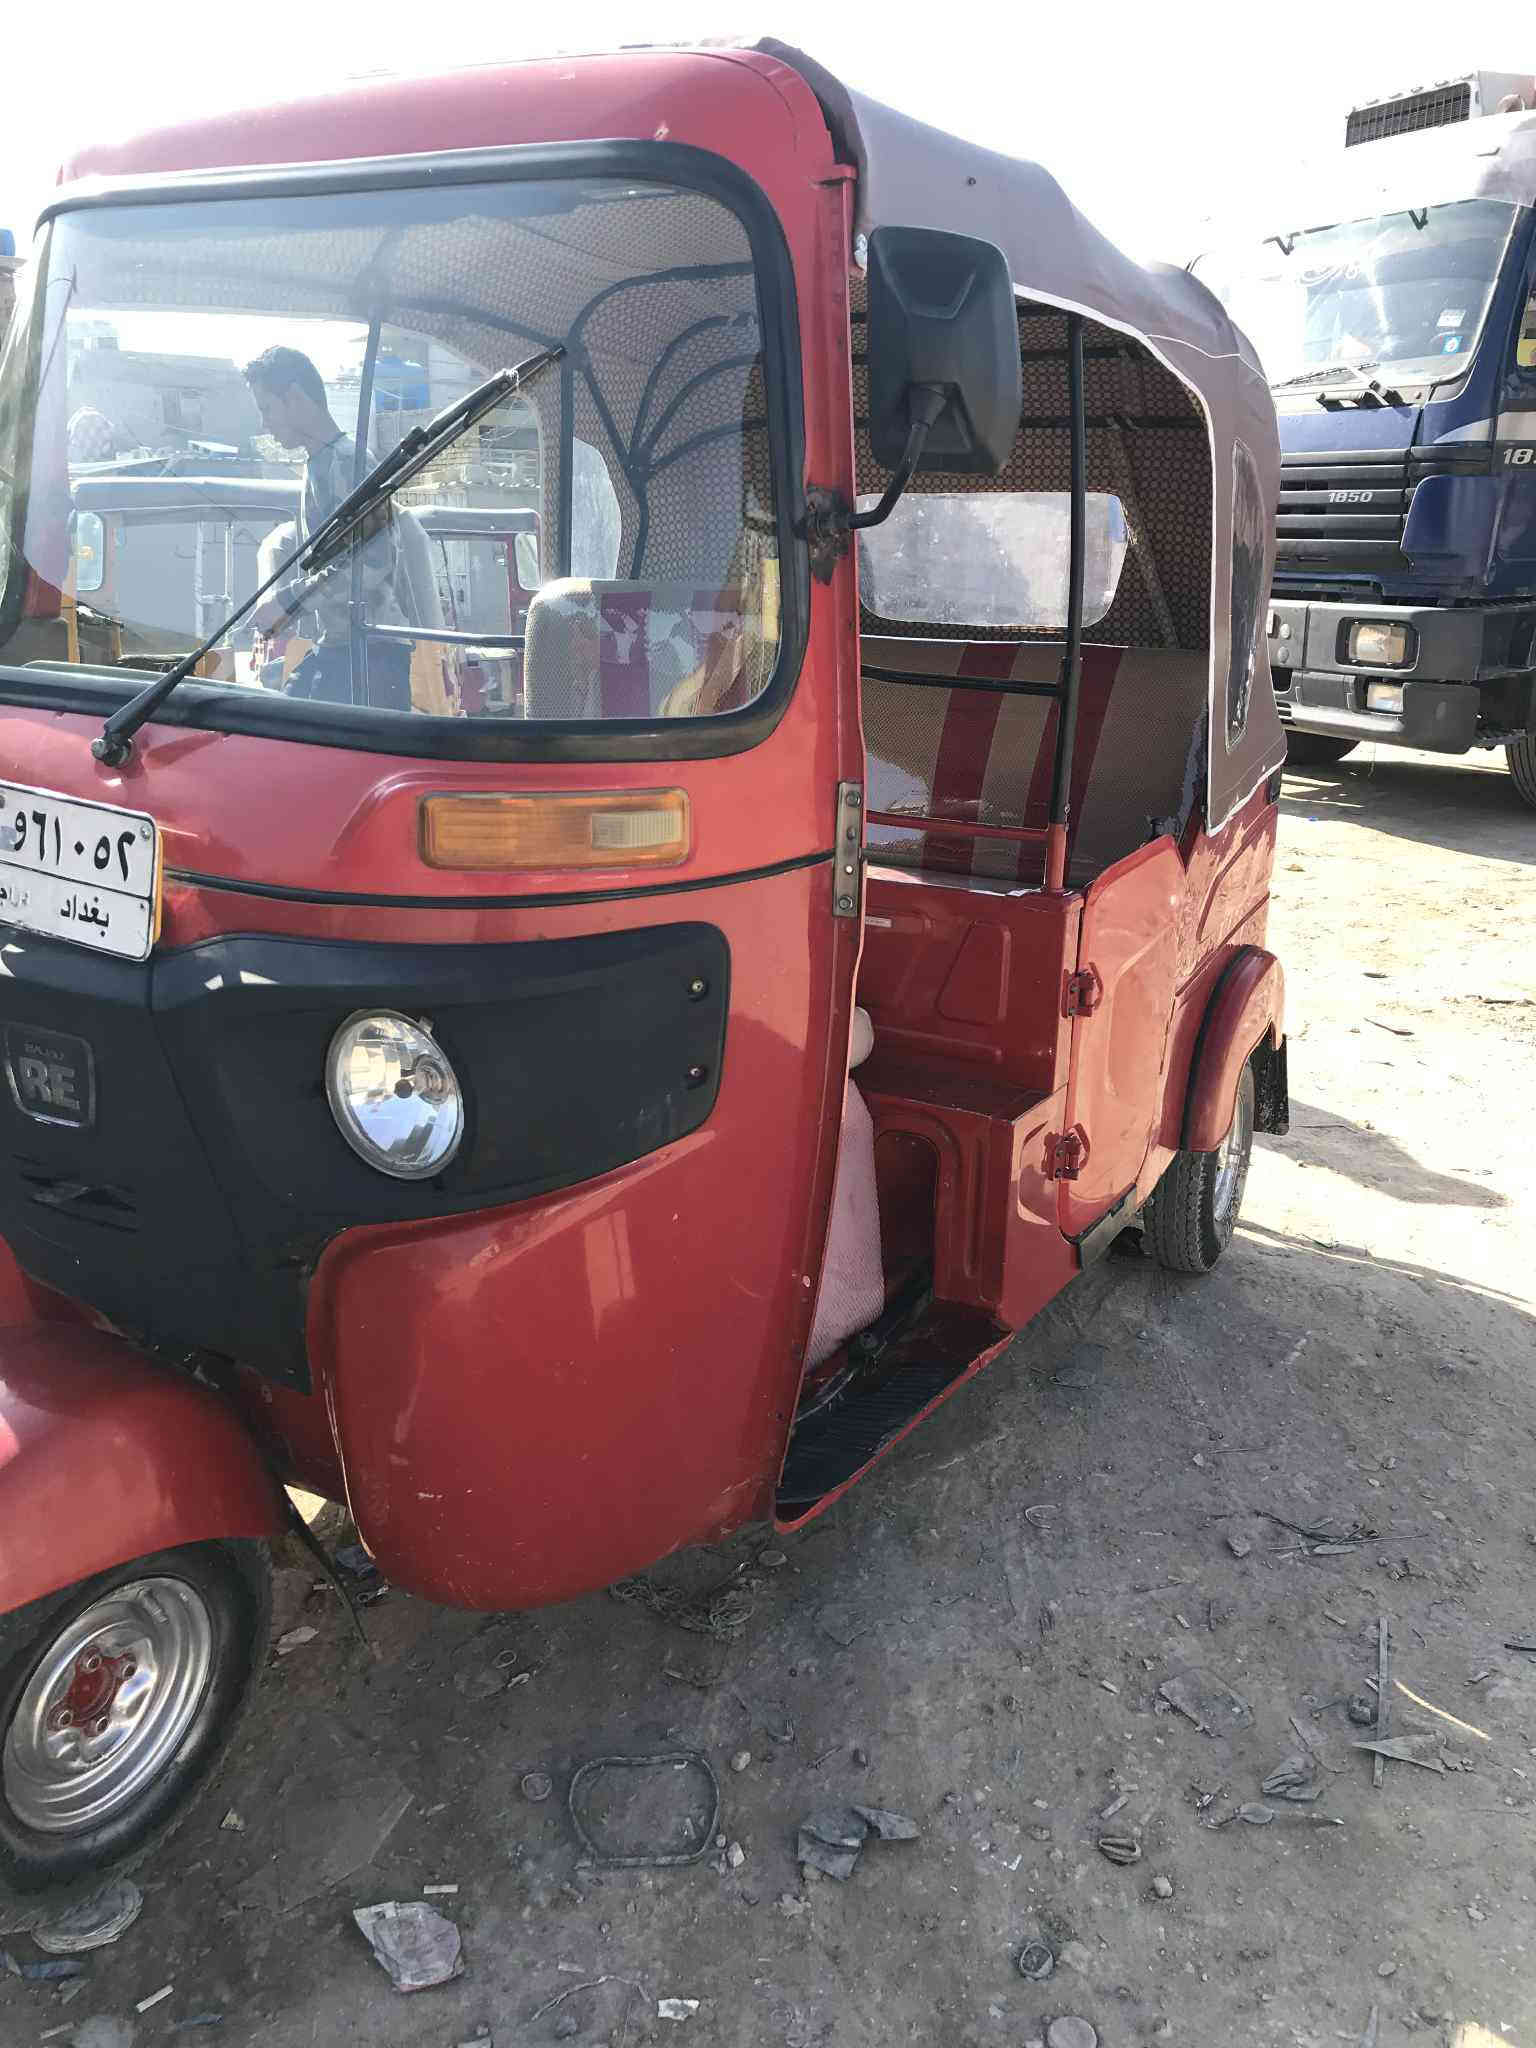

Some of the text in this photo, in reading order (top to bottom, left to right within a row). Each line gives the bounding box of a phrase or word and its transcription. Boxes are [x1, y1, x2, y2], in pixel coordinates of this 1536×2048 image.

[1504, 448, 1536, 465] 18
[1328, 491, 1373, 503] 1850
[60, 895, 110, 938] بغداد
[19, 1056, 80, 1110] RE
